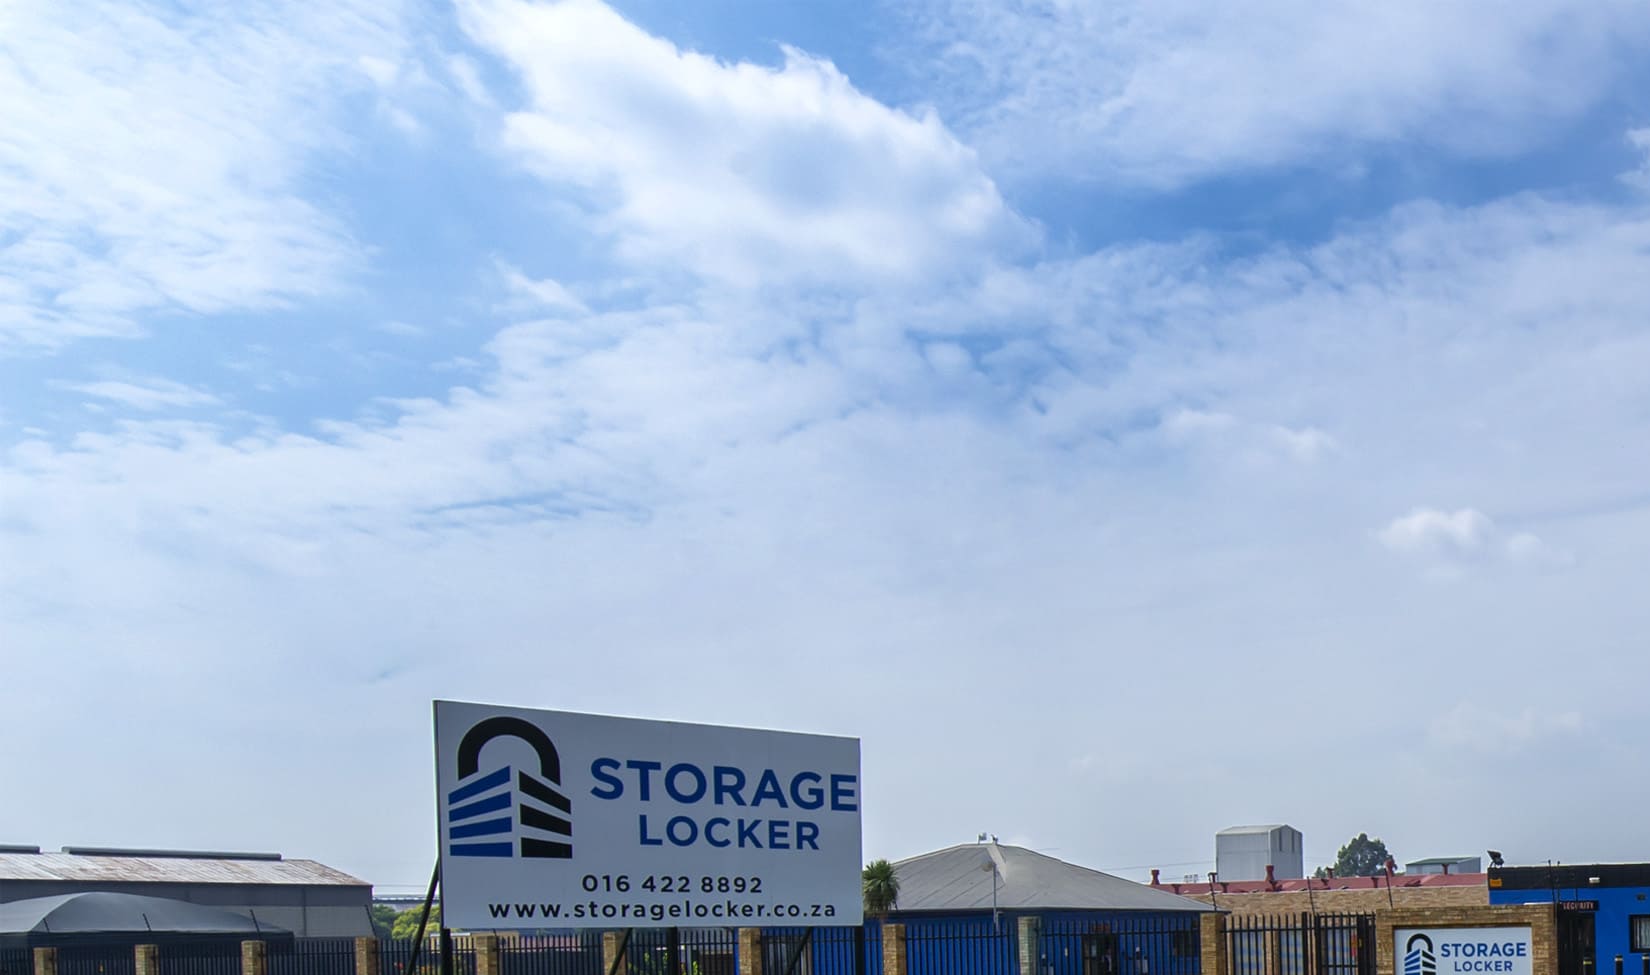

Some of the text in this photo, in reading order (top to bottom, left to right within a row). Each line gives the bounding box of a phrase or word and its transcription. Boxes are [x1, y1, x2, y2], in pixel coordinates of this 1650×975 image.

[590, 757, 858, 812] STORAGE
[639, 814, 820, 850] LOCKER
[582, 874, 763, 894] 016 422 8892
[488, 900, 836, 921] www.storagelocker.co.za
[1440, 942, 1527, 958] STORAGE
[1454, 960, 1513, 972] LOCKER
